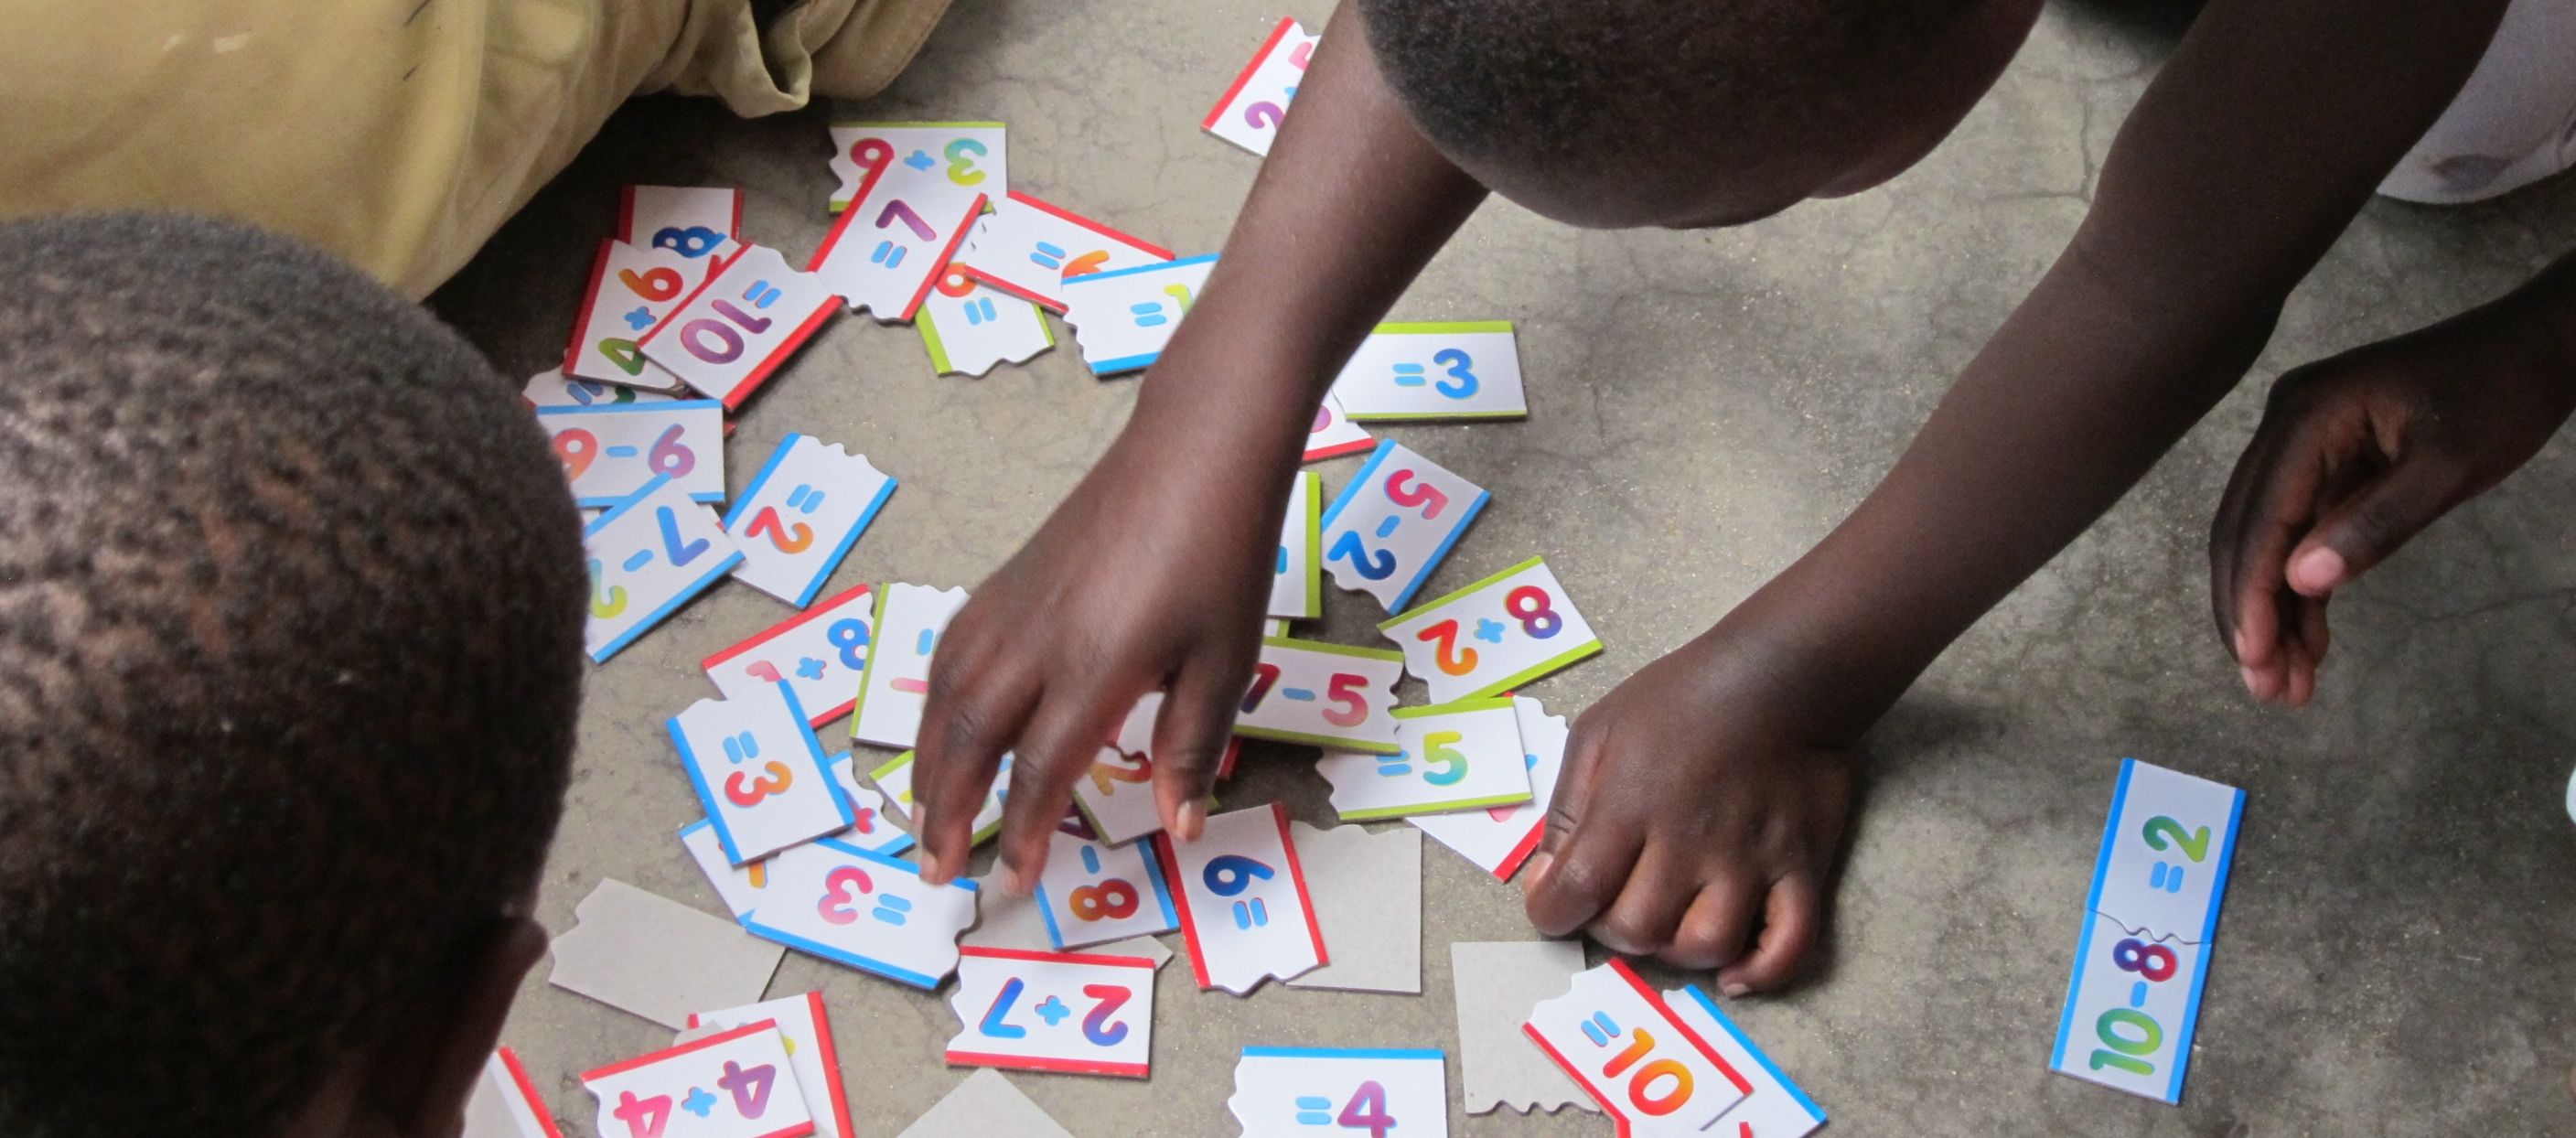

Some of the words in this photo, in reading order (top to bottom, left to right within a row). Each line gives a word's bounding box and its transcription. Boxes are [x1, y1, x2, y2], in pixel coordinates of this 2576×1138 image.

[871, 199, 938, 269] =7
[680, 280, 782, 364] =10
[1392, 349, 1479, 399] =3
[745, 483, 825, 554] =2
[1327, 468, 1448, 581] 5-2
[1417, 585, 1562, 676] 8+2
[722, 731, 792, 808] =3
[1376, 730, 1468, 786] =5
[818, 864, 912, 926] =3
[979, 977, 1132, 1046] 2+7
[1581, 1010, 1694, 1116] =10
[614, 1060, 777, 1138] 4+4
[1295, 1080, 1397, 1138] =4
